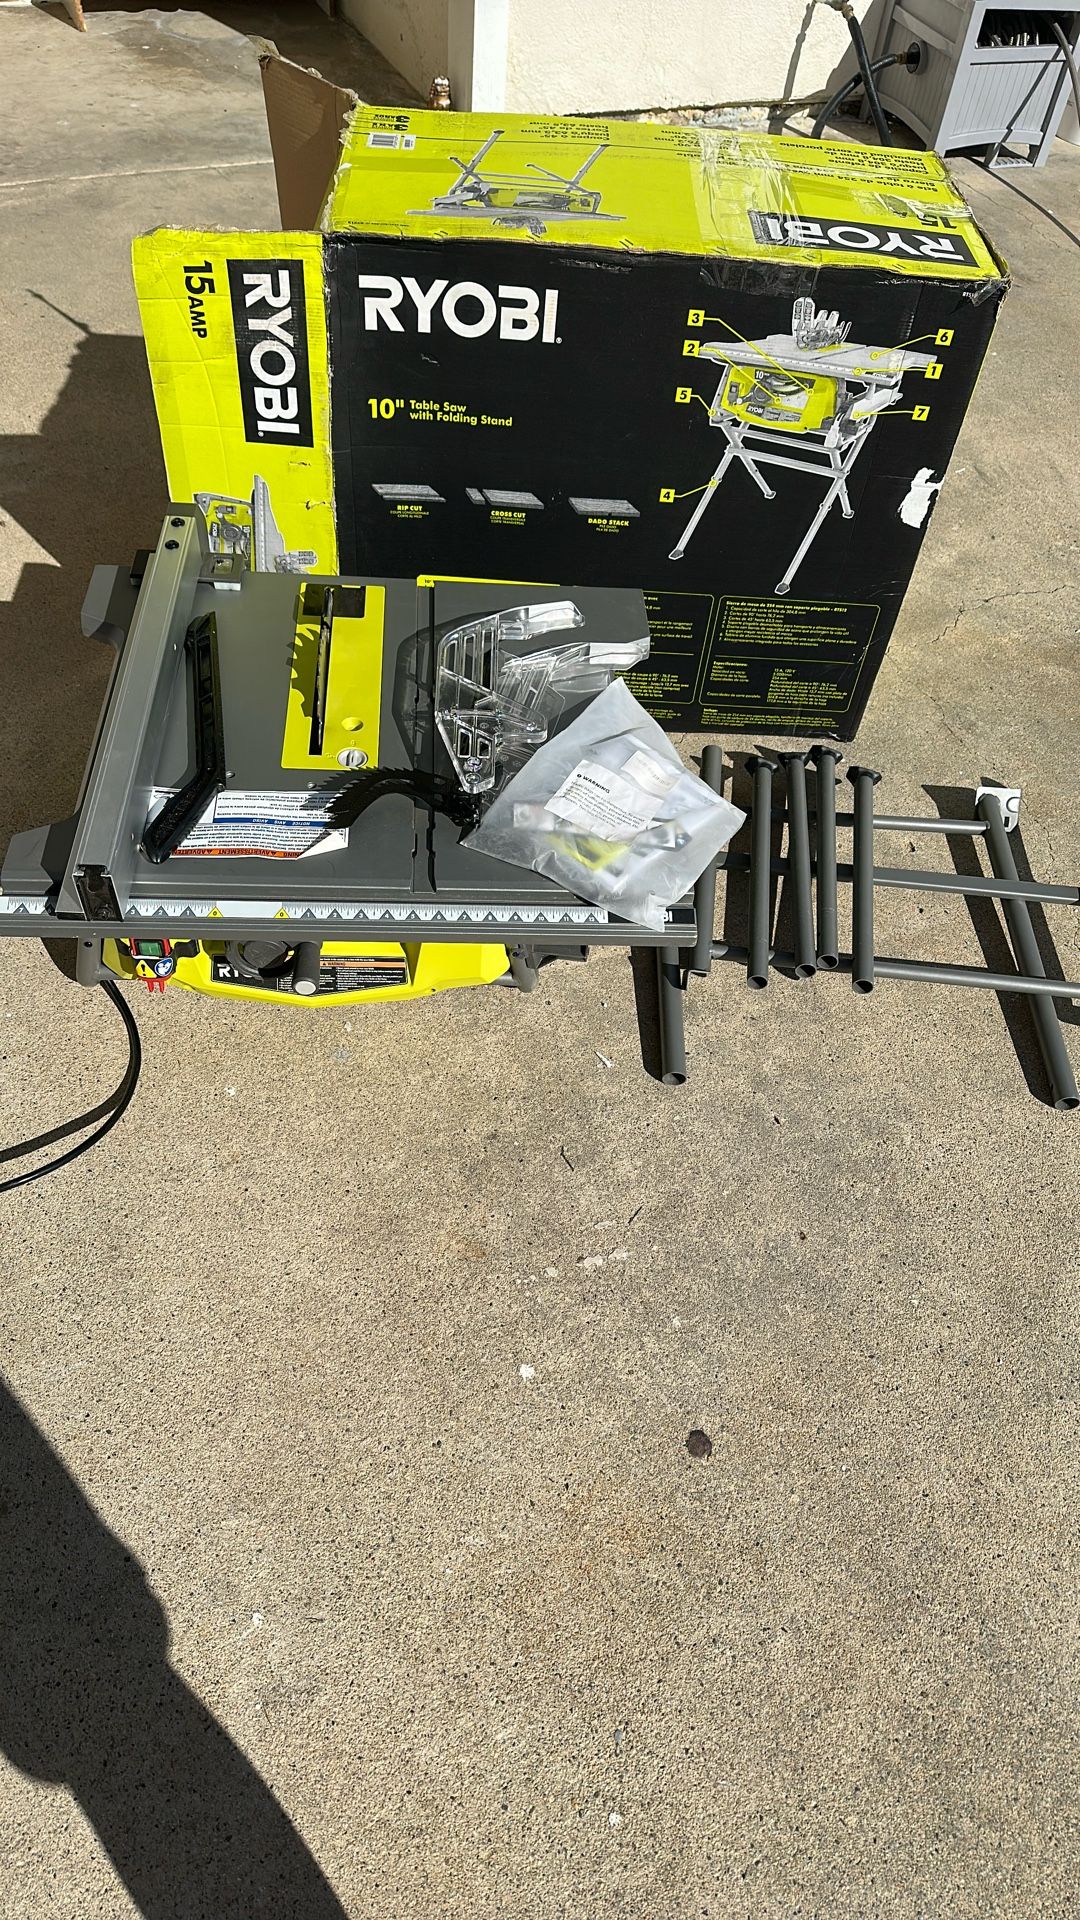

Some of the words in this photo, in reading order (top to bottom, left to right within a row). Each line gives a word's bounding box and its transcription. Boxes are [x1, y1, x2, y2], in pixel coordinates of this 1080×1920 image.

[765, 217, 964, 261] RYOBI
[182, 259, 216, 295] 15
[358, 274, 560, 344] RYOBI
[187, 295, 208, 339] AMP
[691, 313, 700, 324] 3
[939, 331, 949, 342] 6
[242, 269, 301, 436] RYOBI
[686, 343, 696, 354] 2
[931, 365, 937, 377] 1
[679, 389, 688, 400] 5
[367, 398, 405, 421] 10"
[409, 399, 441, 412] Table
[443, 401, 467, 413] Saw
[409, 410, 434, 421] with
[436, 411, 478, 426] Folding
[480, 414, 513, 427] Stand
[917, 408, 926, 418] 7
[663, 490, 671, 500] 4
[490, 510, 513, 518] CROSS
[608, 519, 630, 527] STACK
[582, 775, 611, 794] WARNING
